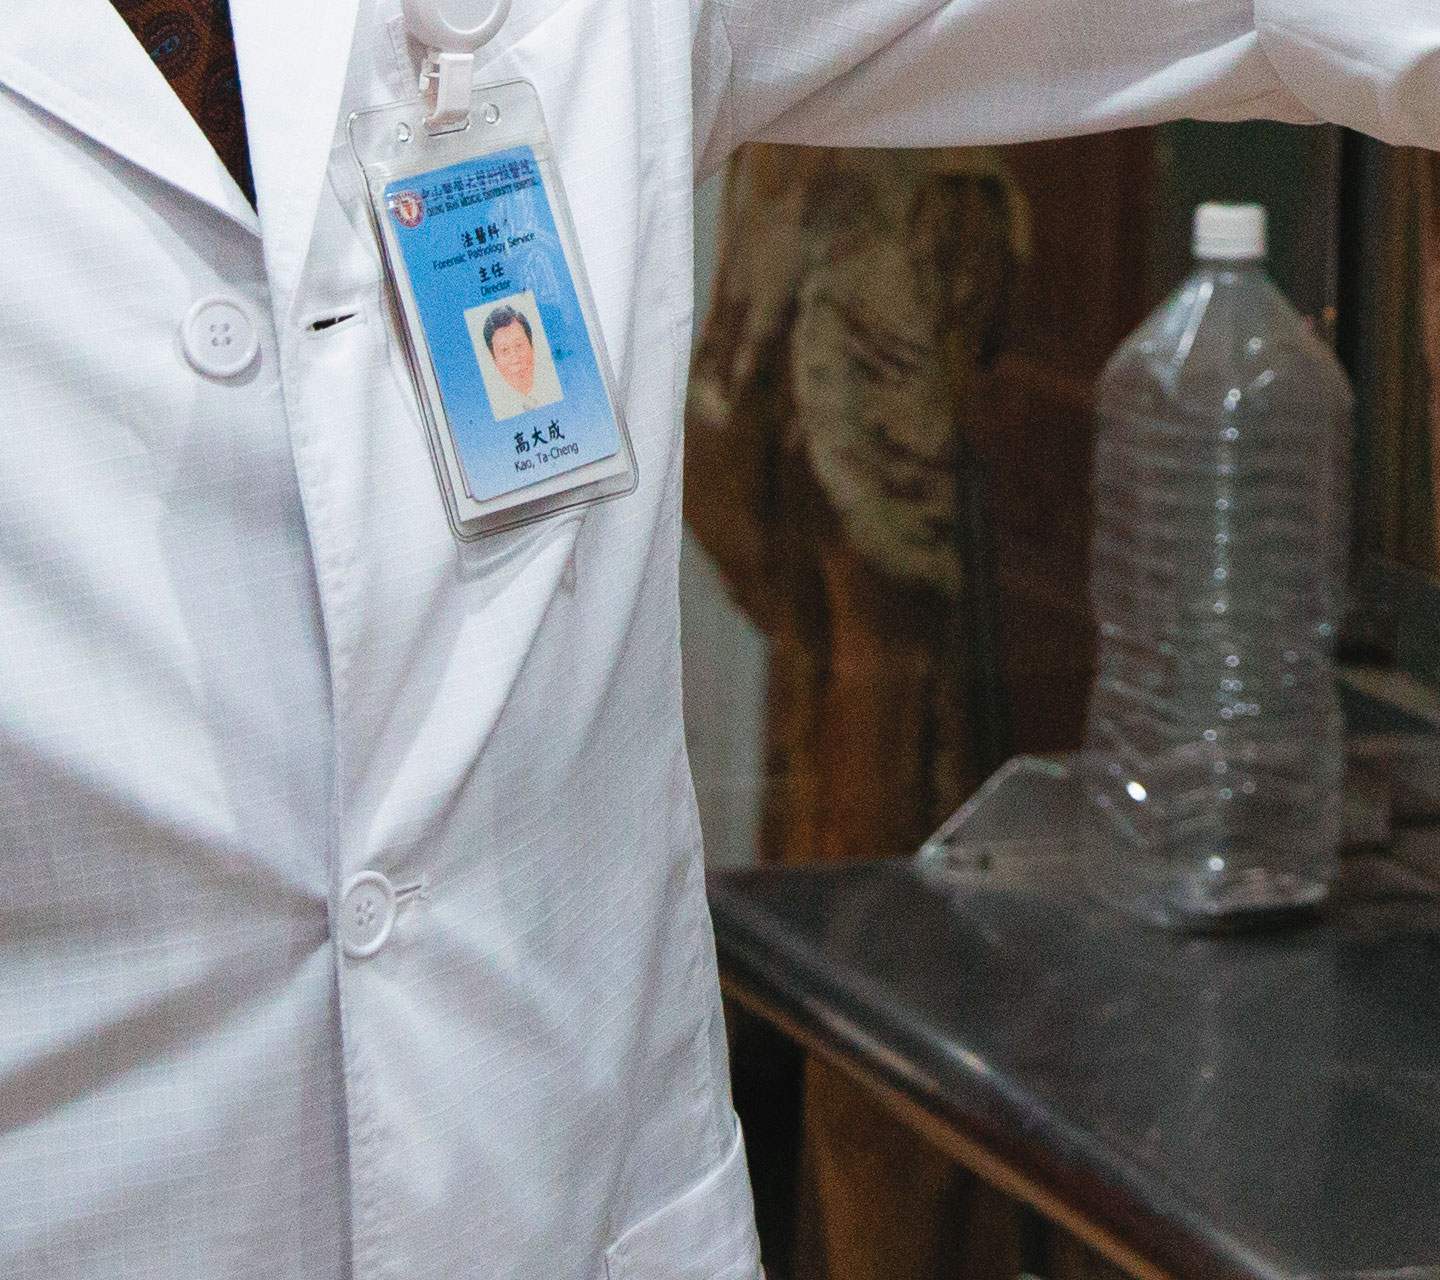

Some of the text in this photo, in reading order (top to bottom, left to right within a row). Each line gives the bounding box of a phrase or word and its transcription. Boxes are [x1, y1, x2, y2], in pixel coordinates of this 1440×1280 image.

[460, 222, 500, 249] 法醫科
[433, 232, 535, 271] Forensic Pathology Service
[479, 262, 504, 284] 主任
[480, 280, 511, 297] Director
[514, 419, 566, 455] 高大成
[514, 442, 579, 473] Kao, Ta-Cheng
